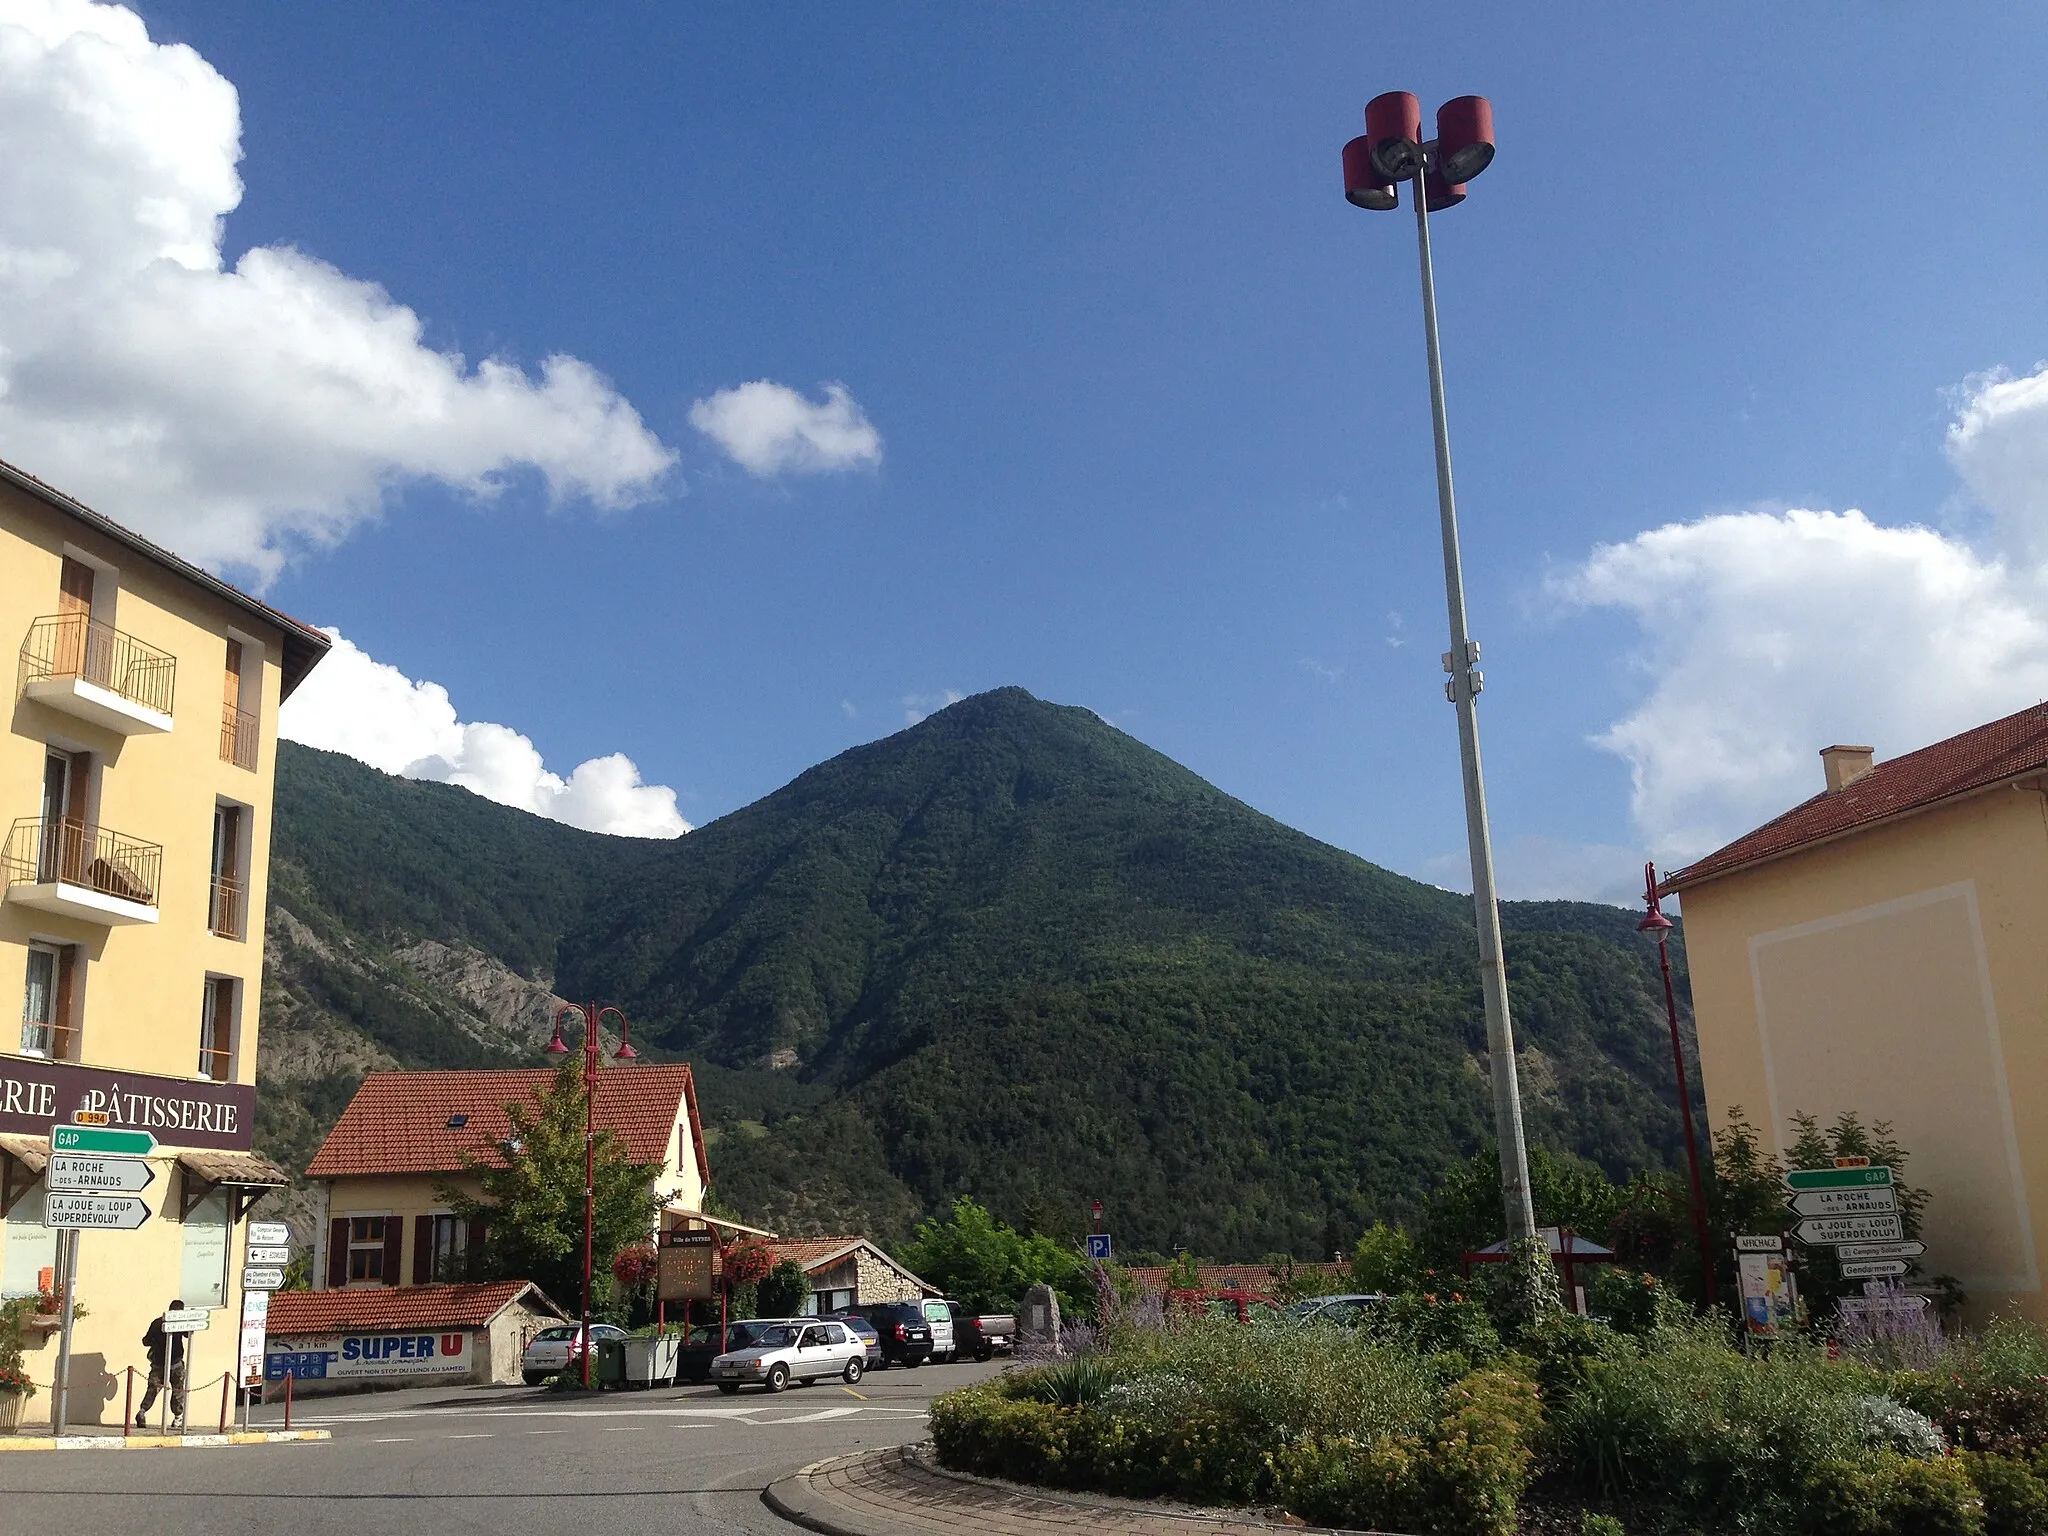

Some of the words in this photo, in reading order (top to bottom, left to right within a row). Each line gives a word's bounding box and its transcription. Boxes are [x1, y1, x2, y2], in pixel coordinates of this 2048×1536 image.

[0, 1078, 57, 1117] RIE
[89, 1082, 238, 1134] PÂTISSERIE
[76, 1111, 84, 1122] D
[88, 1112, 106, 1123] 994
[58, 1132, 80, 1146] GAP
[55, 1161, 67, 1171] LA
[72, 1162, 104, 1173] ROCHE
[1864, 1172, 1886, 1182] GAP
[1820, 1194, 1833, 1203] LA
[1837, 1192, 1870, 1202] ROCHE
[52, 1199, 64, 1210] LA
[68, 1200, 94, 1211] JOUE
[108, 1201, 133, 1212] LOUP
[51, 1211, 120, 1225] SUPERDÉVOLUY
[1811, 1222, 1824, 1231] LA
[1828, 1220, 1854, 1230] JOUE
[1869, 1218, 1895, 1228] LOUP
[1742, 1239, 1777, 1249] AFFICHAGE
[1846, 1264, 1897, 1274] Gendarmerie
[342, 1336, 435, 1361] SUPER
[441, 1334, 463, 1357] U
